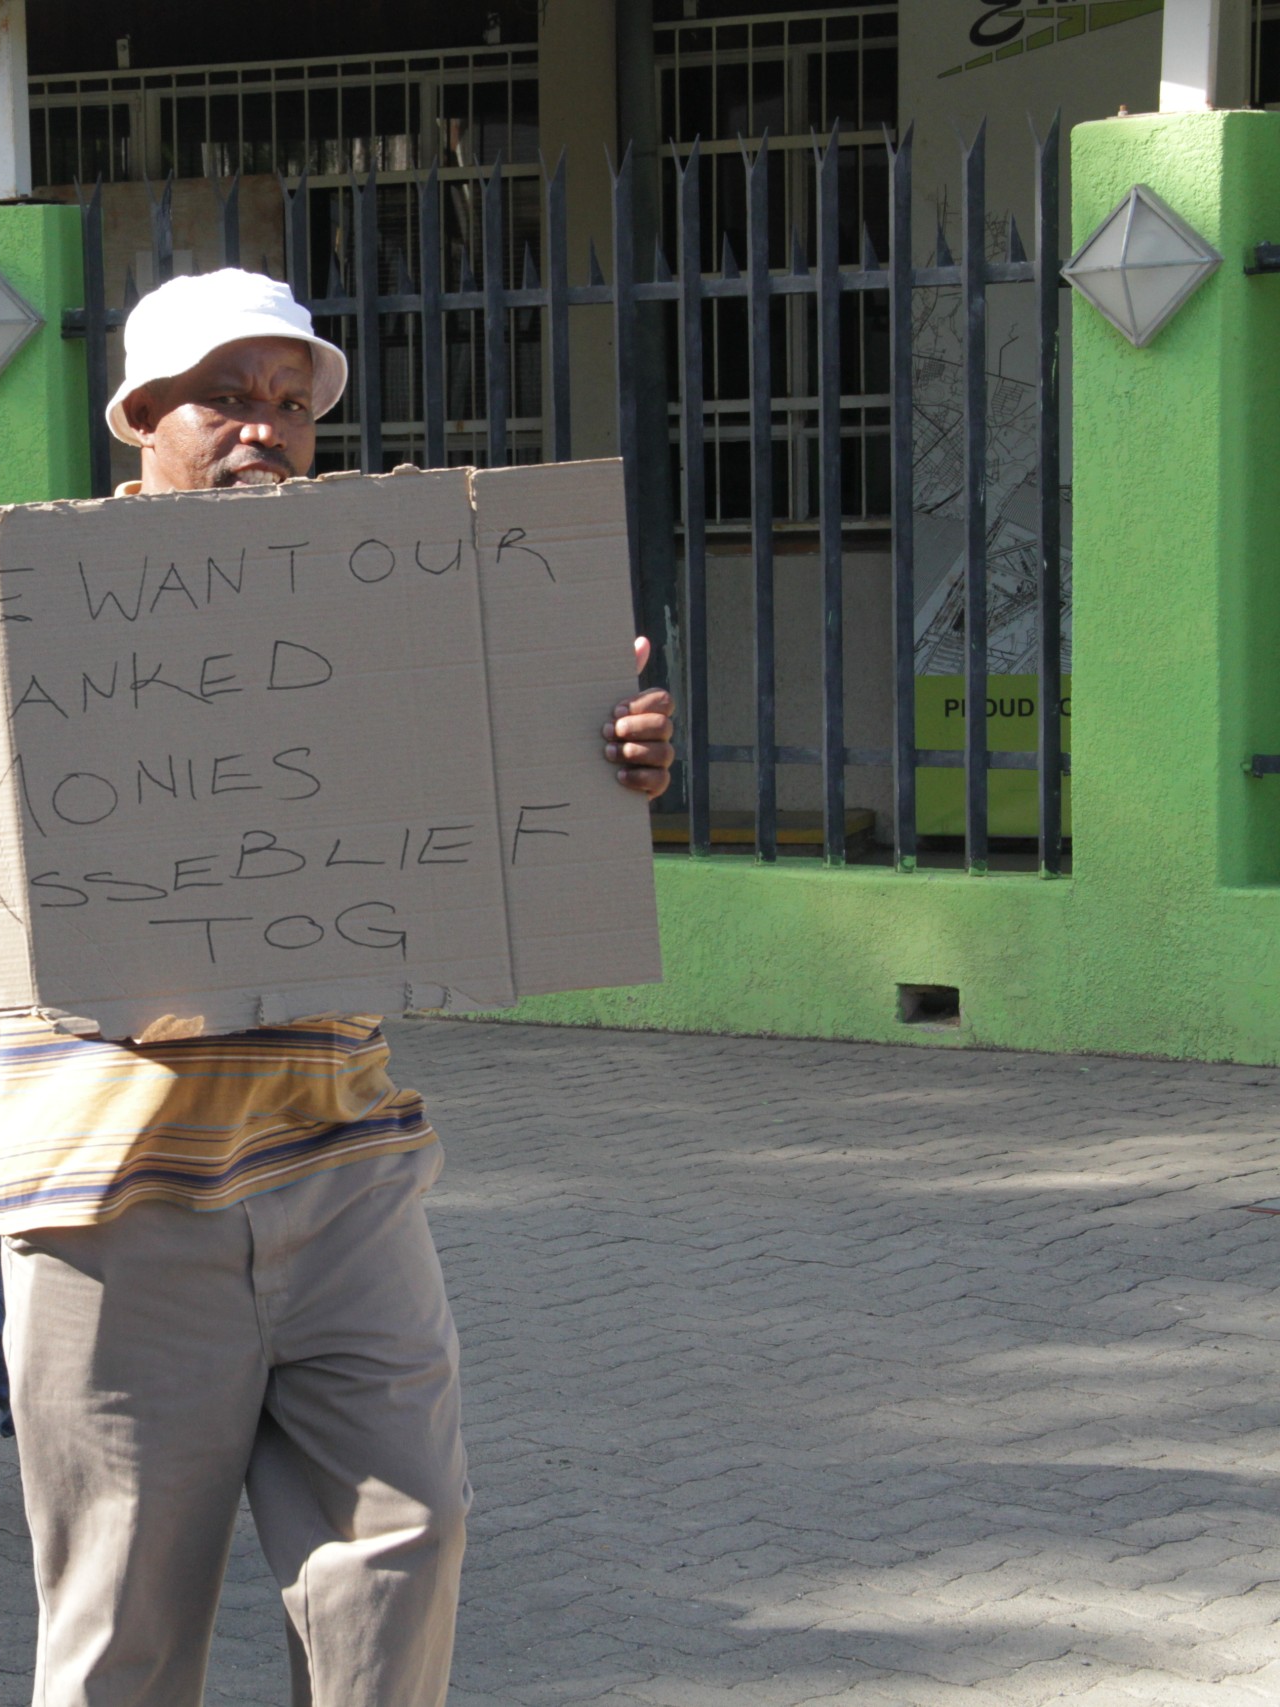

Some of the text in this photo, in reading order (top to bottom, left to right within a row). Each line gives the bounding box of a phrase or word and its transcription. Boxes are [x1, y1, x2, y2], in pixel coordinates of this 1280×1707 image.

[80, 542, 310, 622] WANT
[348, 528, 557, 583] OUR
[945, 698, 1035, 717] POUD
[149, 901, 408, 963] TOG
